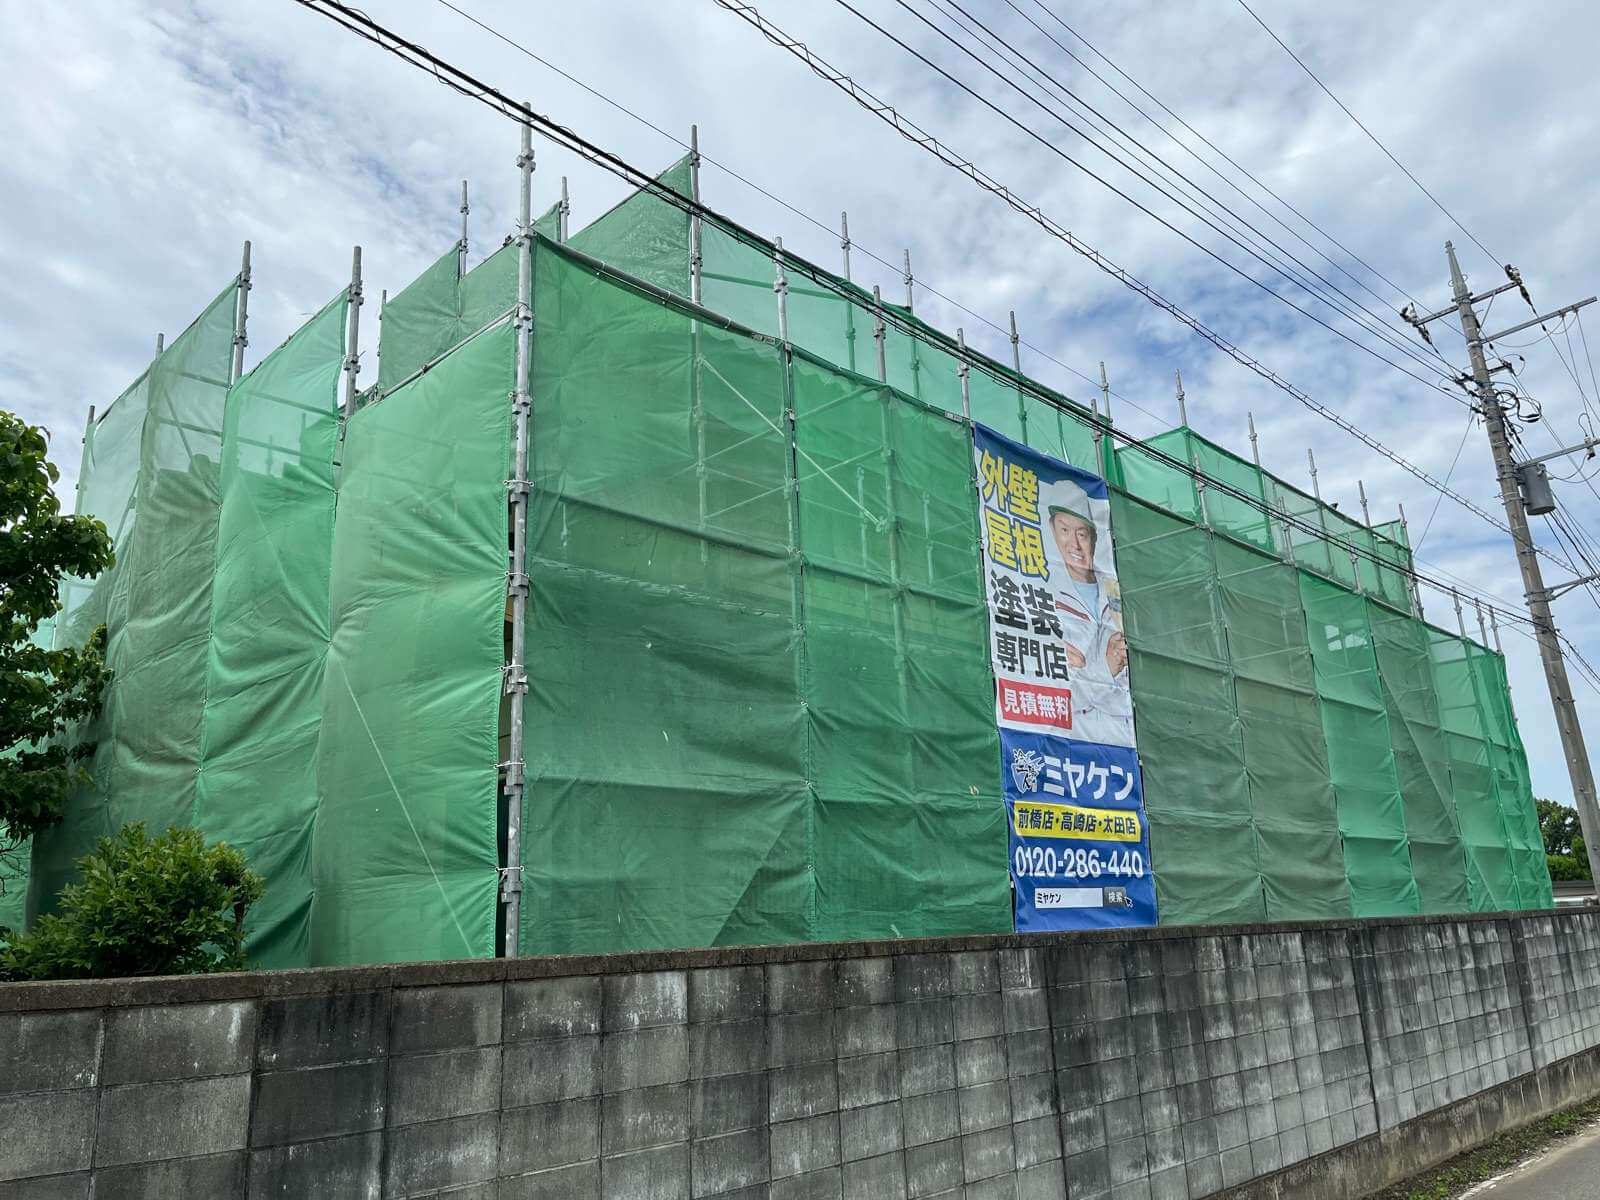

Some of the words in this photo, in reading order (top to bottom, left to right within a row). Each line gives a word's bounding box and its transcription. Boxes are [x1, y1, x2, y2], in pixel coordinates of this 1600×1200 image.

[980, 448, 1041, 526] 外壁
[984, 505, 1050, 582] 屋根
[991, 569, 1064, 640] 塗装
[995, 631, 1070, 682] 専門店
[1003, 687, 1069, 722] 見積無料
[1043, 755, 1134, 801] ミヤケン
[1015, 845, 1144, 878] 0120-286-440
[1036, 892, 1062, 904] ミヤケン
